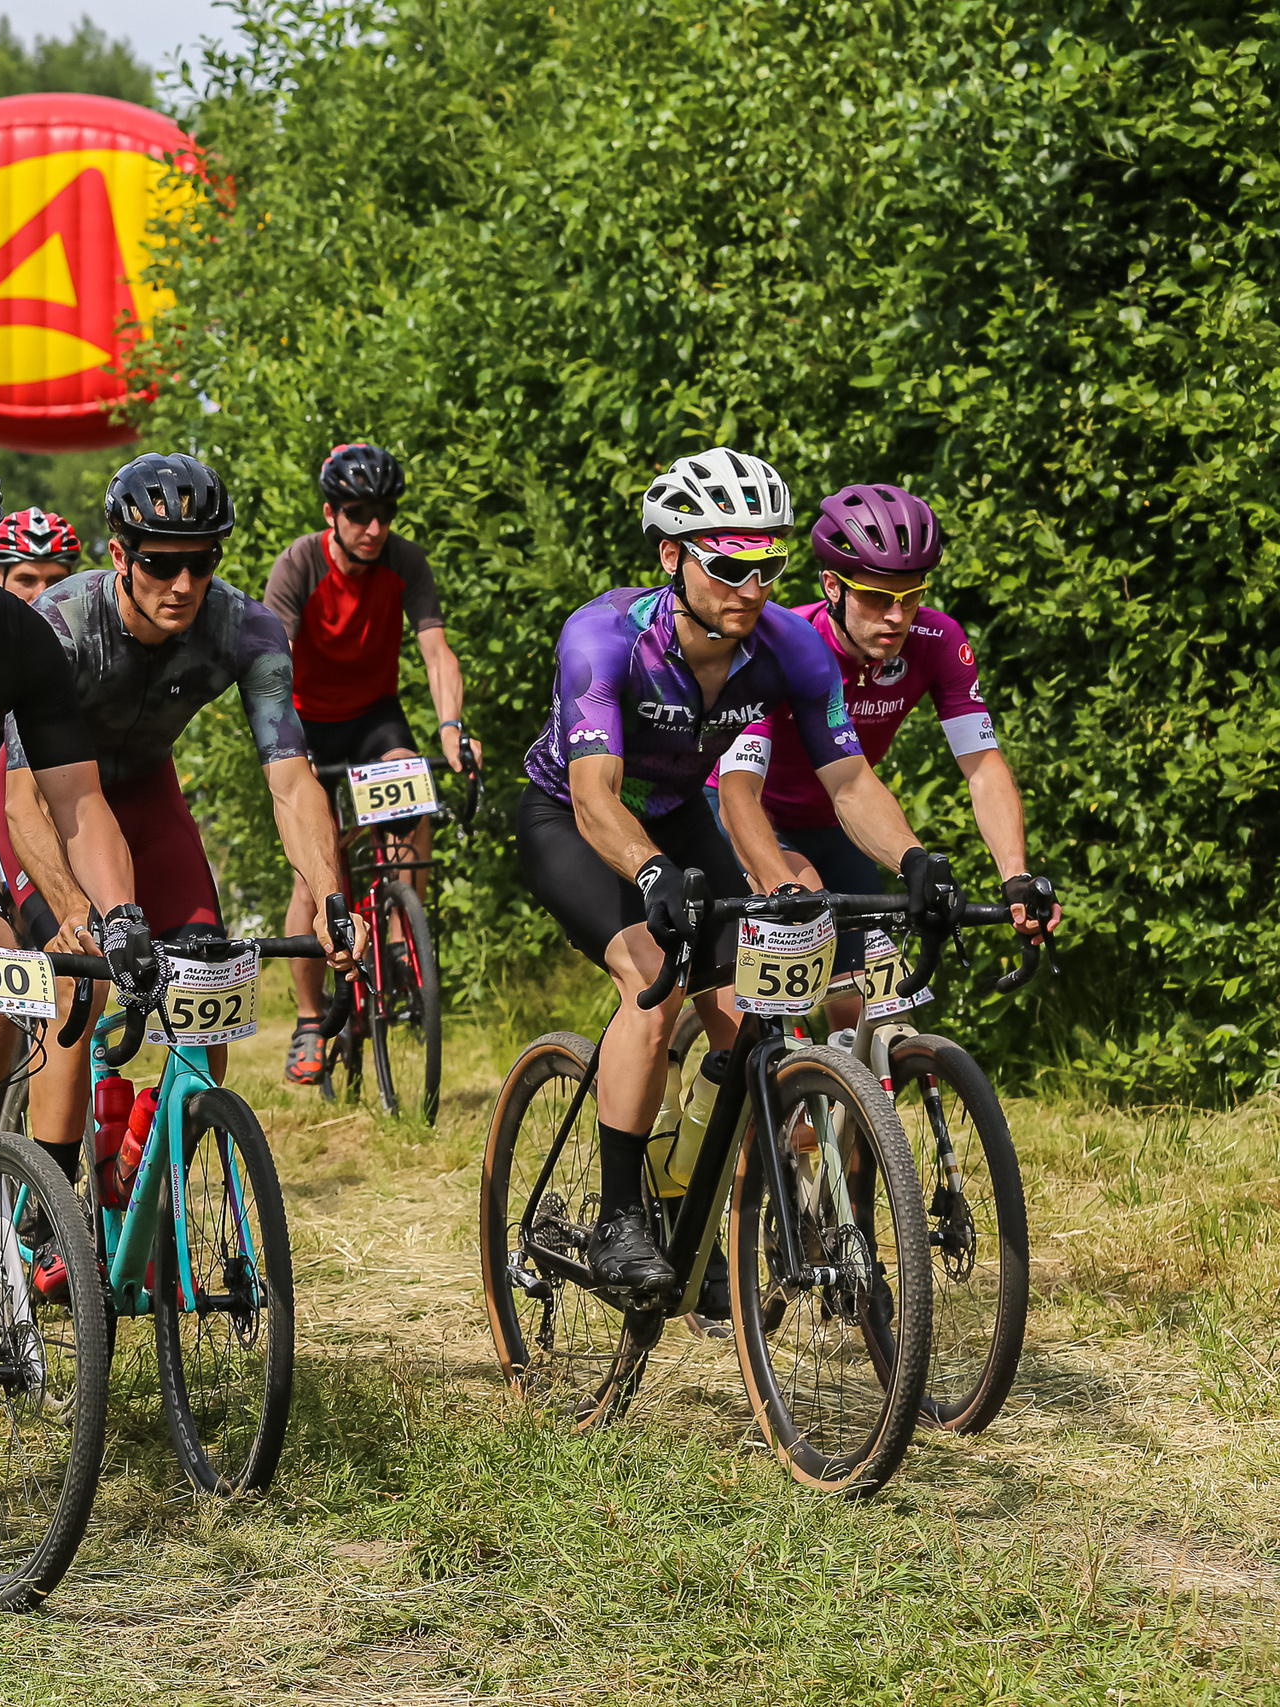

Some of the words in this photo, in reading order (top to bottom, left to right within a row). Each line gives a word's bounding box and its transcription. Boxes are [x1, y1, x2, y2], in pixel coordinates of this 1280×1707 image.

[875, 697, 905, 717] Sport
[368, 780, 416, 809] 591
[769, 928, 815, 939] AUTHOR
[816, 922, 824, 938] 3
[768, 936, 814, 946] GRAND-PRIX
[183, 973, 230, 982] GRAND-PRIX
[184, 966, 231, 976] AUTHOR
[234, 962, 242, 977] 3
[756, 957, 824, 998] 582
[865, 961, 895, 999] 57
[171, 994, 243, 1030] 592
